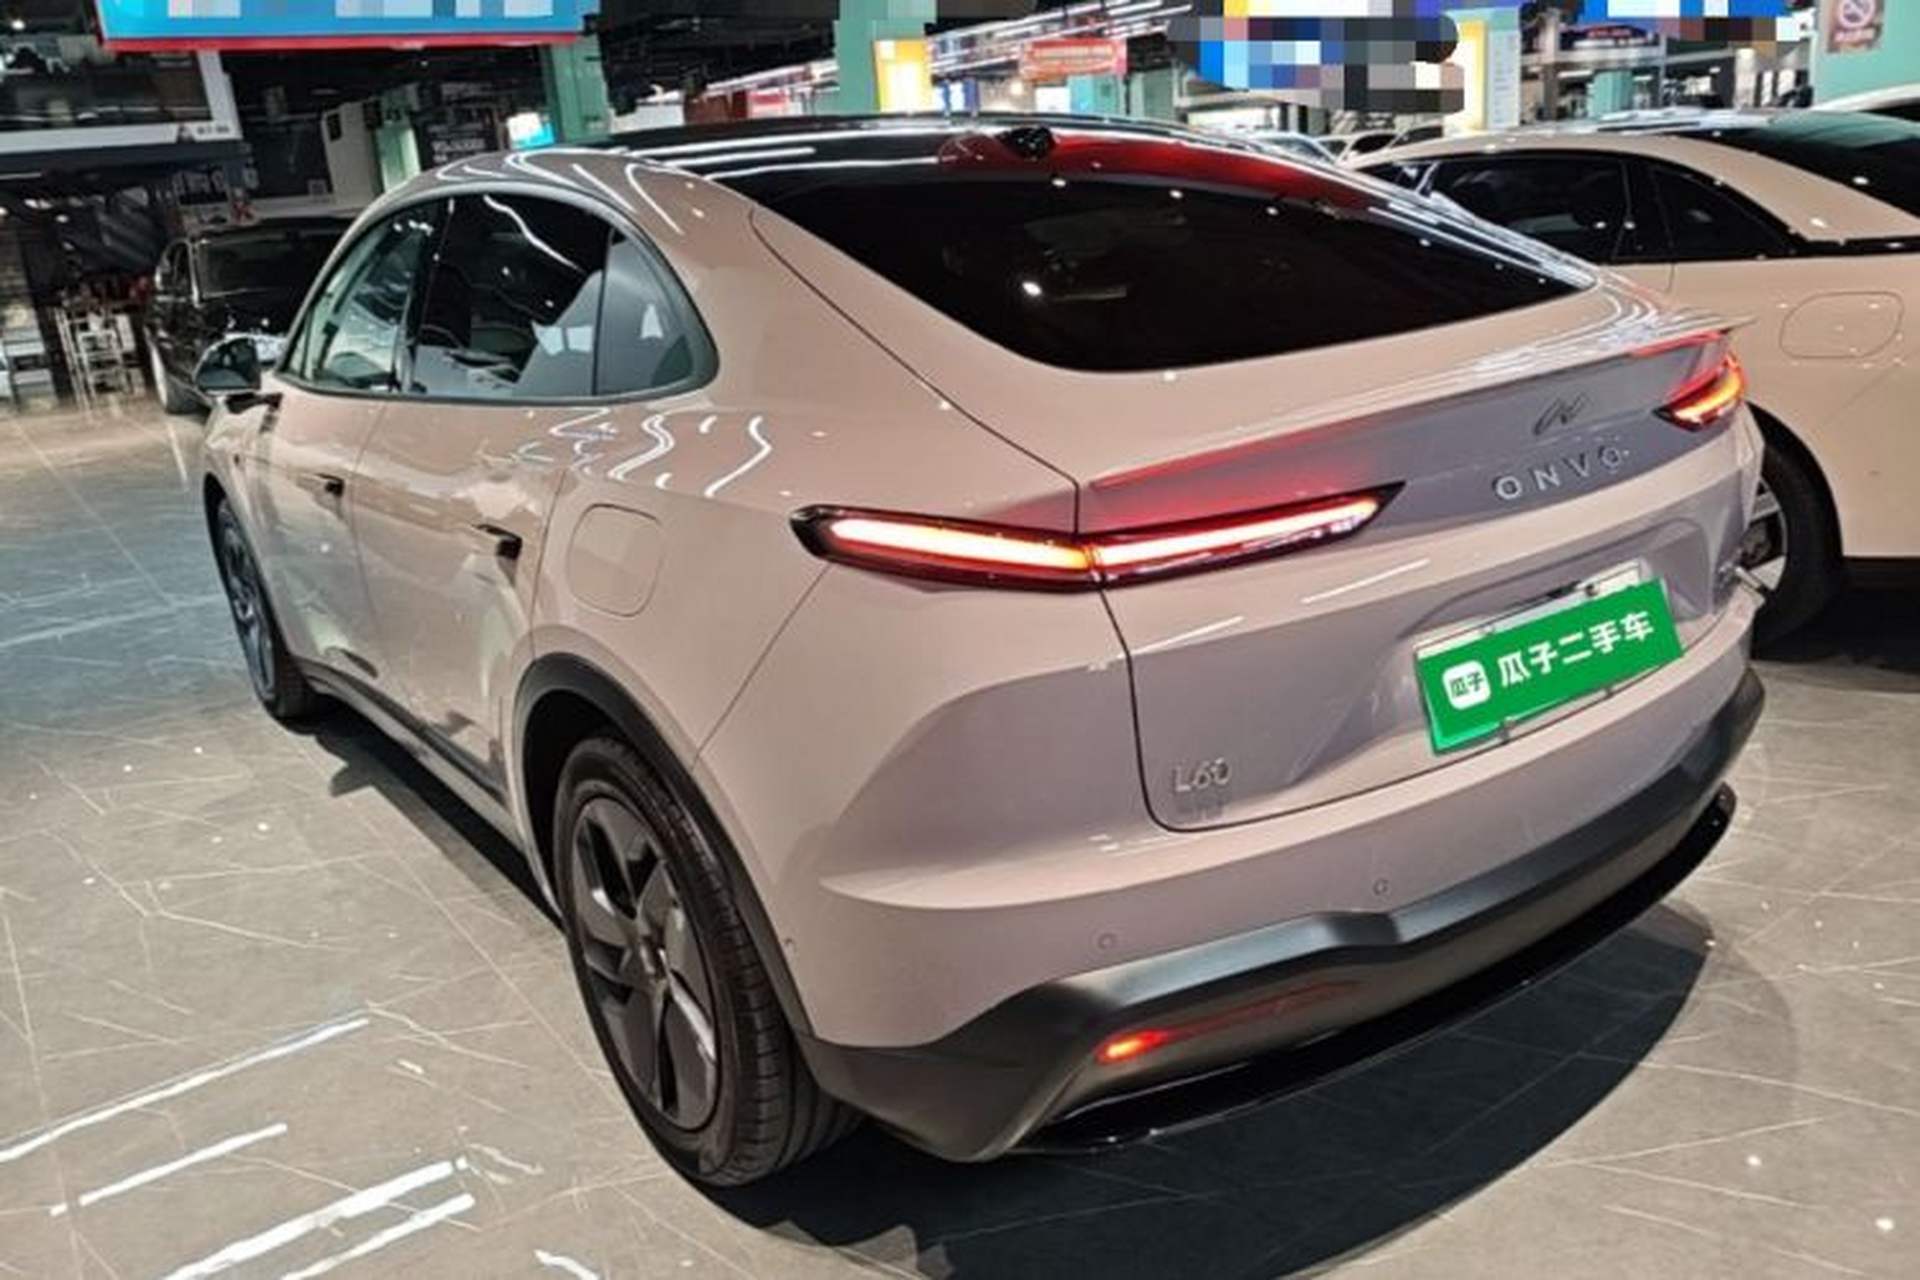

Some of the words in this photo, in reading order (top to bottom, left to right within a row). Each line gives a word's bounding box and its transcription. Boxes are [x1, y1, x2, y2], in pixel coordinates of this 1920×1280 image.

[1494, 446, 1622, 499] ONVO
[1497, 611, 1654, 687] 瓜子二手车
[1449, 671, 1485, 698] 瓜子
[1174, 757, 1232, 792] L60
